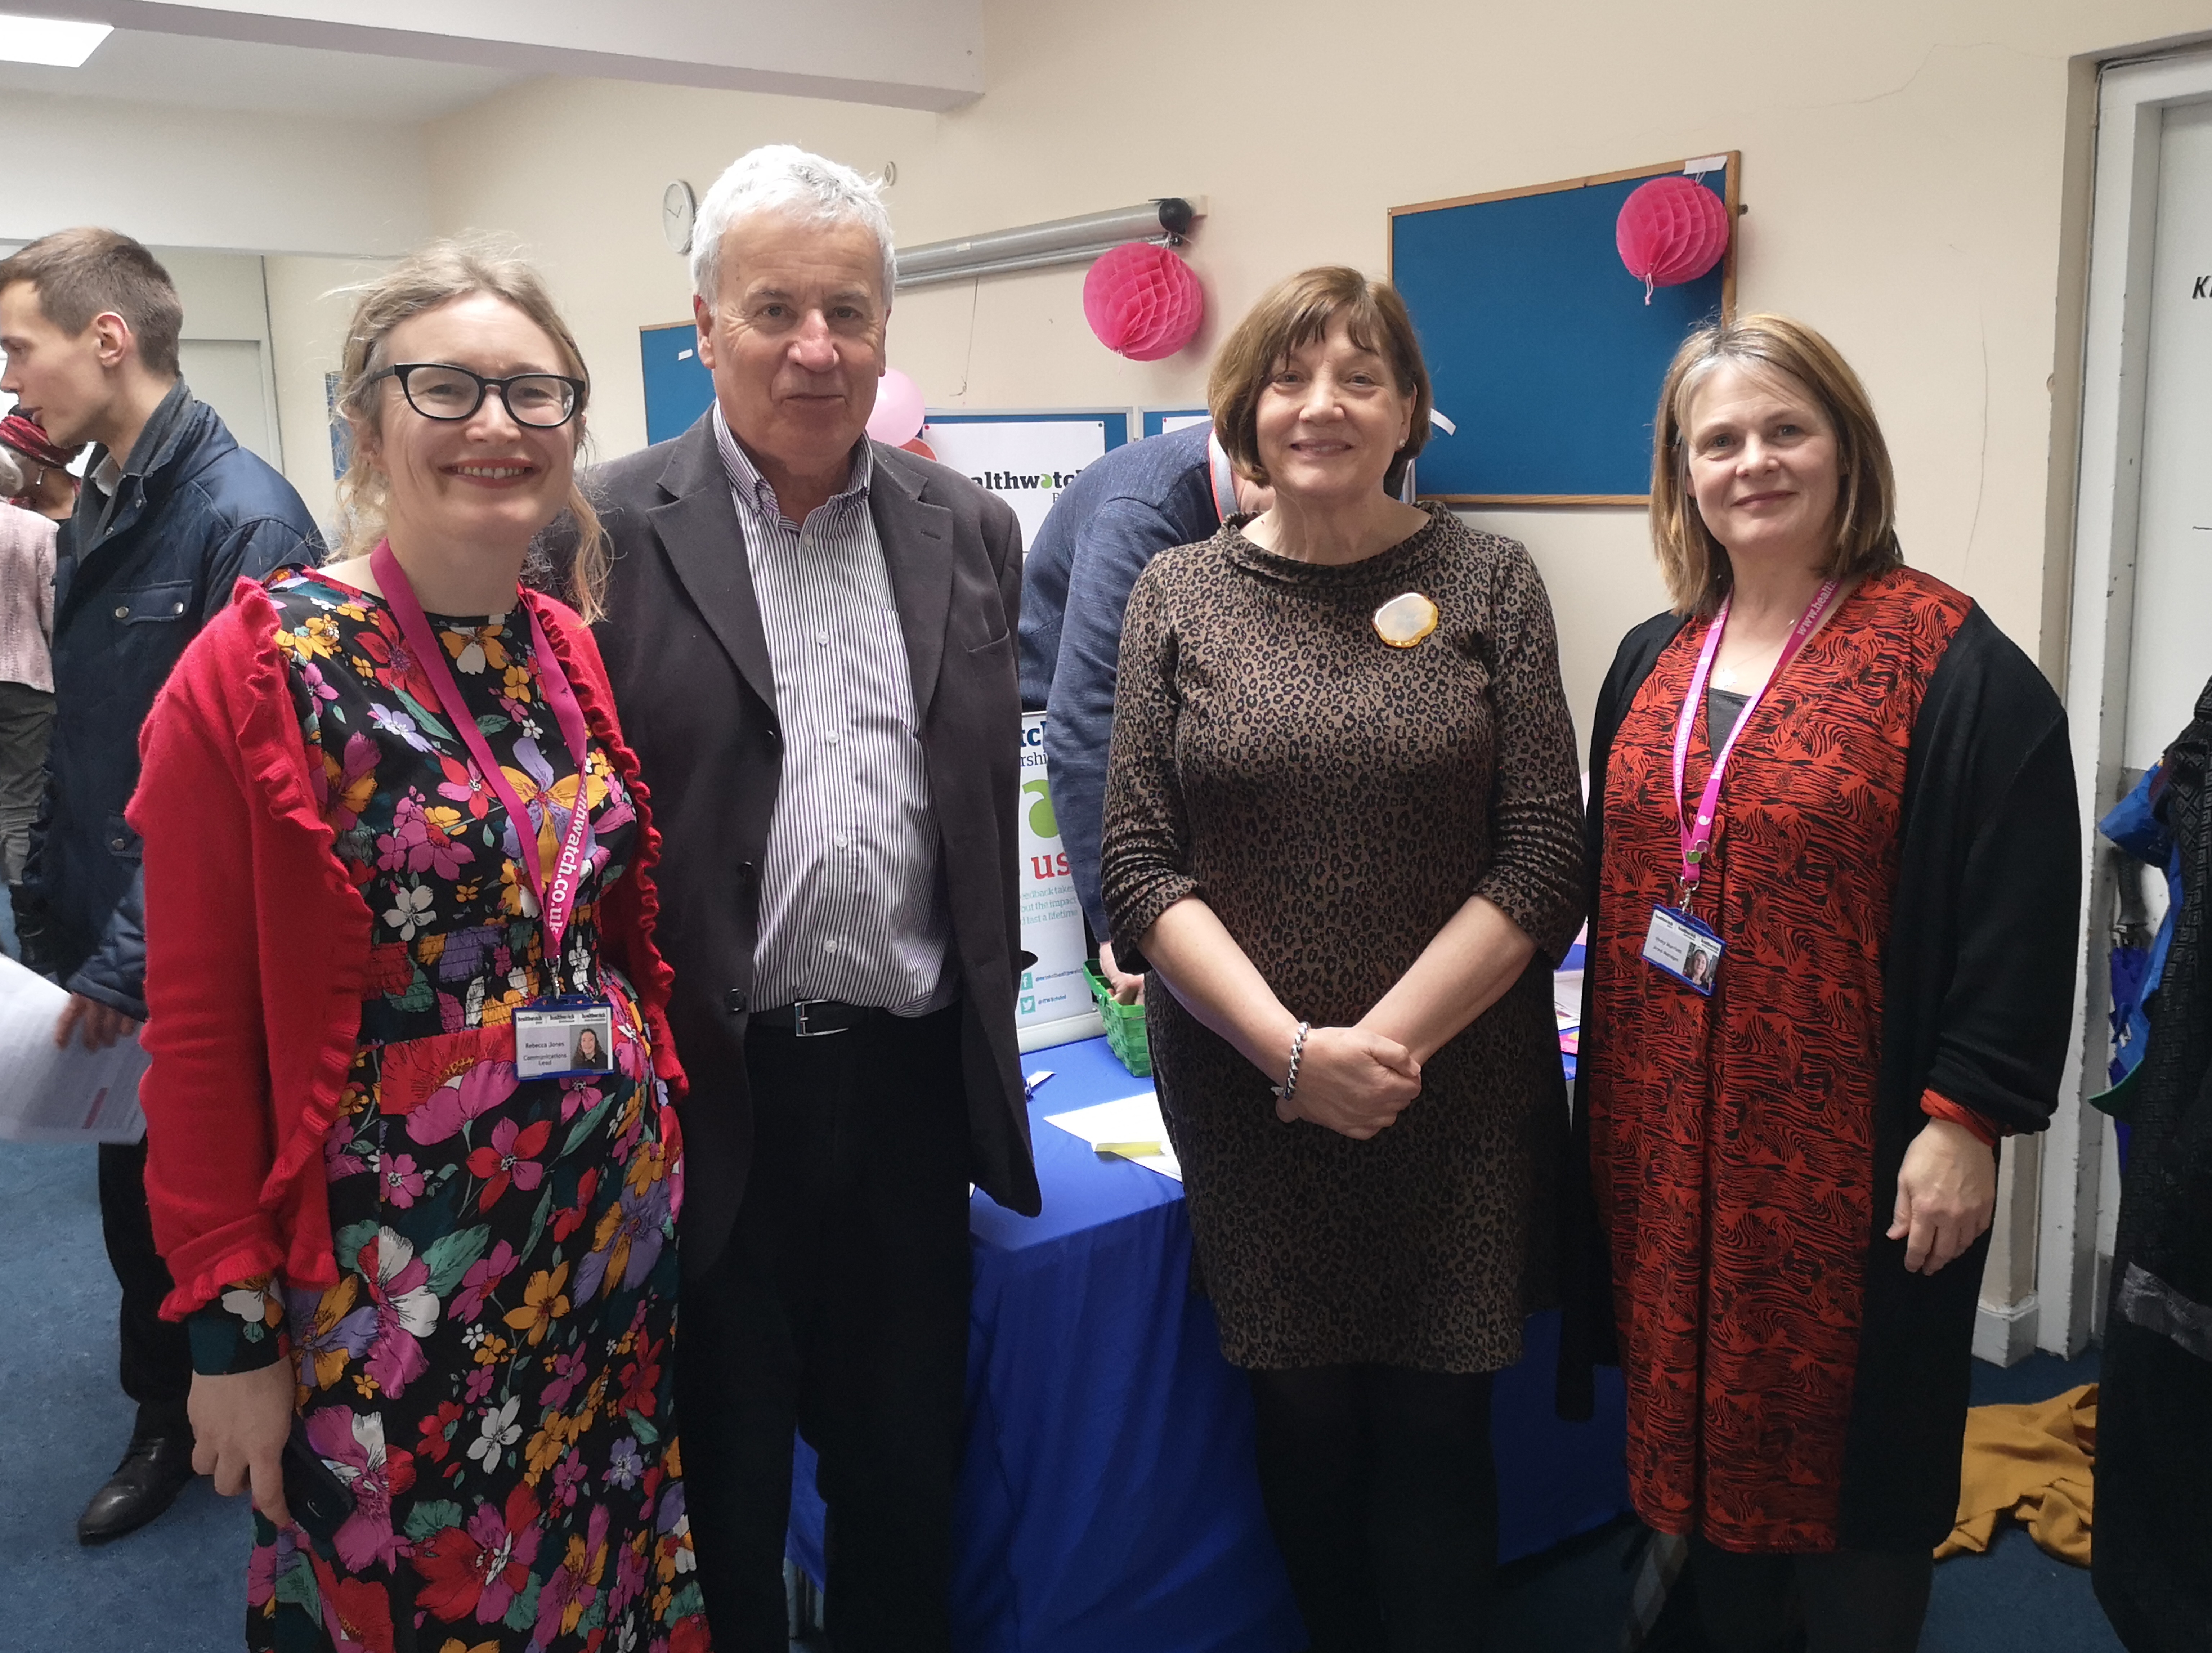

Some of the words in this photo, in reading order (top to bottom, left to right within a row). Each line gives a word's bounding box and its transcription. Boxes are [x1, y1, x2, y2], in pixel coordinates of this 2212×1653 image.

[1031, 852, 1071, 880] us
[1035, 901, 1048, 910] the
[1049, 897, 1076, 908] impact
[1027, 915, 1041, 924] last
[1048, 909, 1078, 920] lifetime
